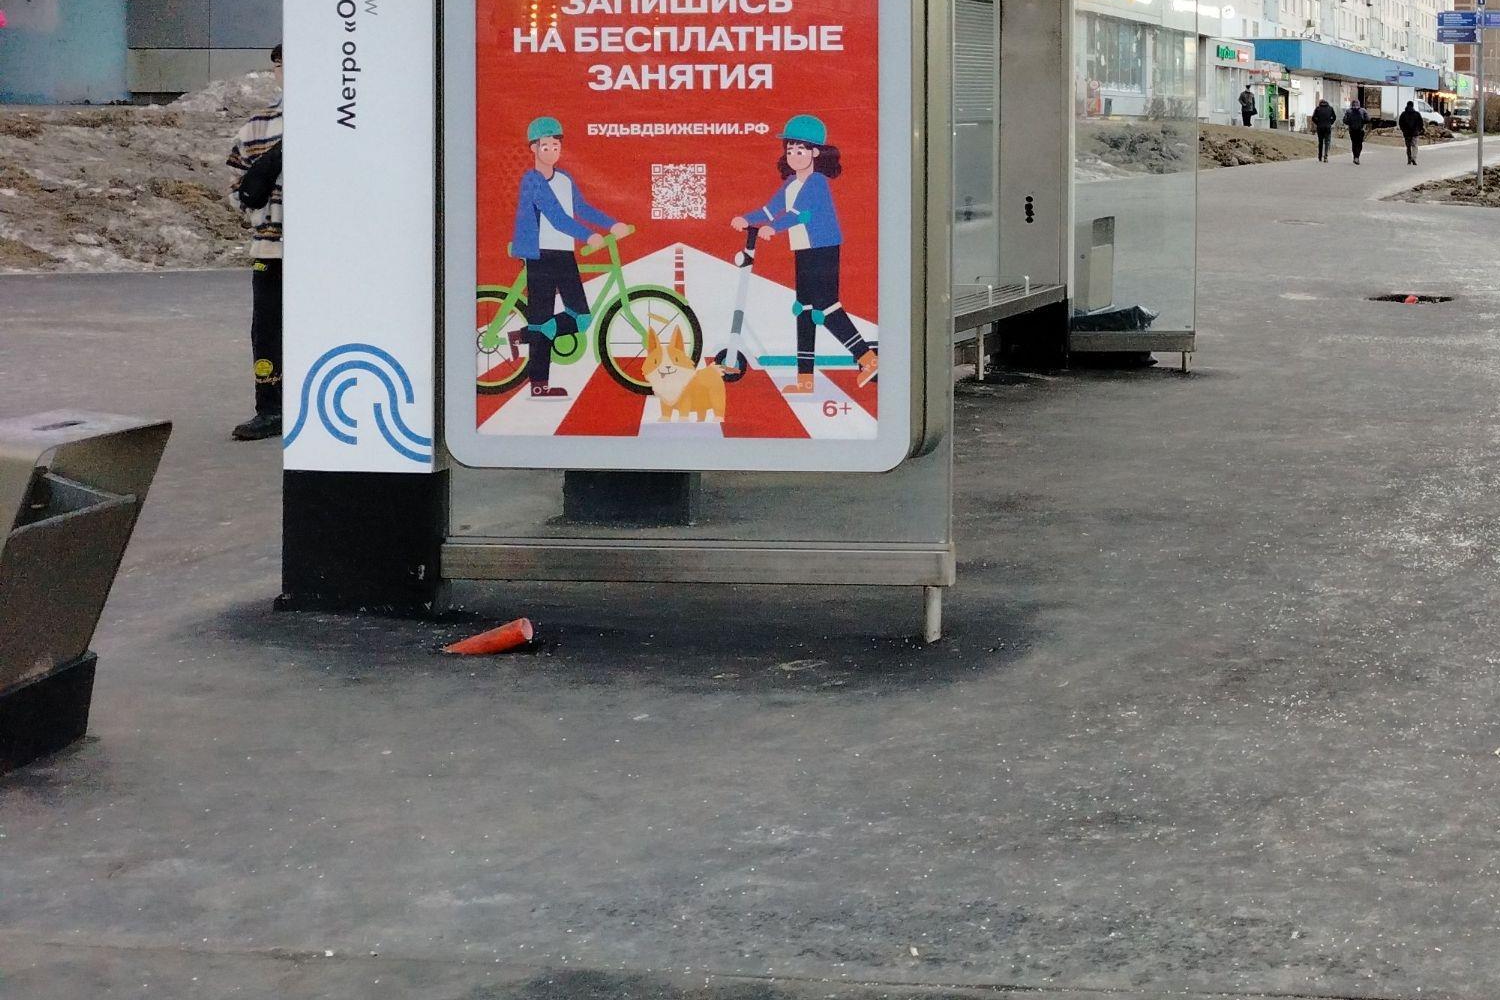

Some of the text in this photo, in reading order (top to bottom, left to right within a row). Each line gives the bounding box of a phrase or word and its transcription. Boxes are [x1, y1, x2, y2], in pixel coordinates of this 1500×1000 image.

[513, 25, 844, 53] НА БЕСПЛАТНЫЕ
[336, 41, 362, 129] Метро
[587, 63, 774, 90] ЗАНЯТИЯ
[587, 123, 770, 136] БУДЬВДВИЖЕНИИ.РФ
[822, 400, 852, 418] 6+
